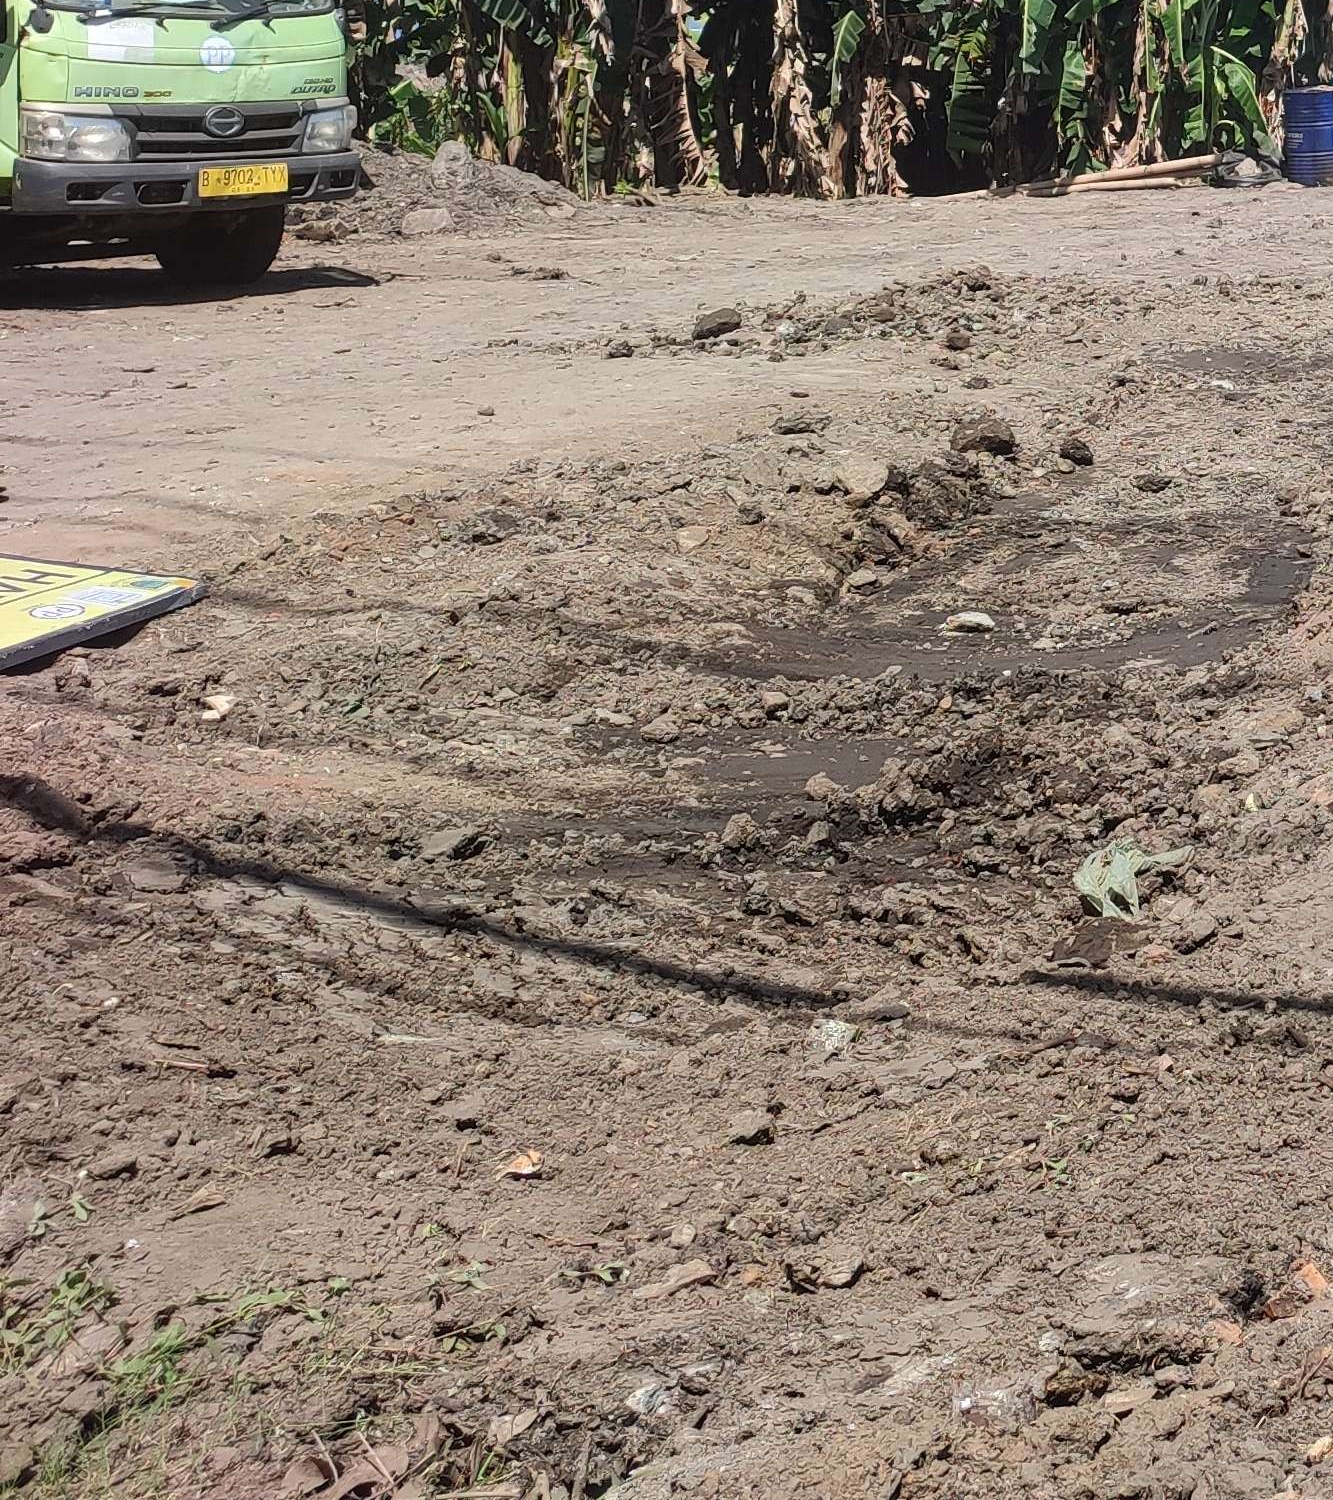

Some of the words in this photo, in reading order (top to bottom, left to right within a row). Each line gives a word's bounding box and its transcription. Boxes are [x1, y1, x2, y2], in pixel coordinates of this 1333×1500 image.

[74, 86, 139, 98] HINO
[202, 170, 210, 186] B
[262, 165, 286, 182] TYX
